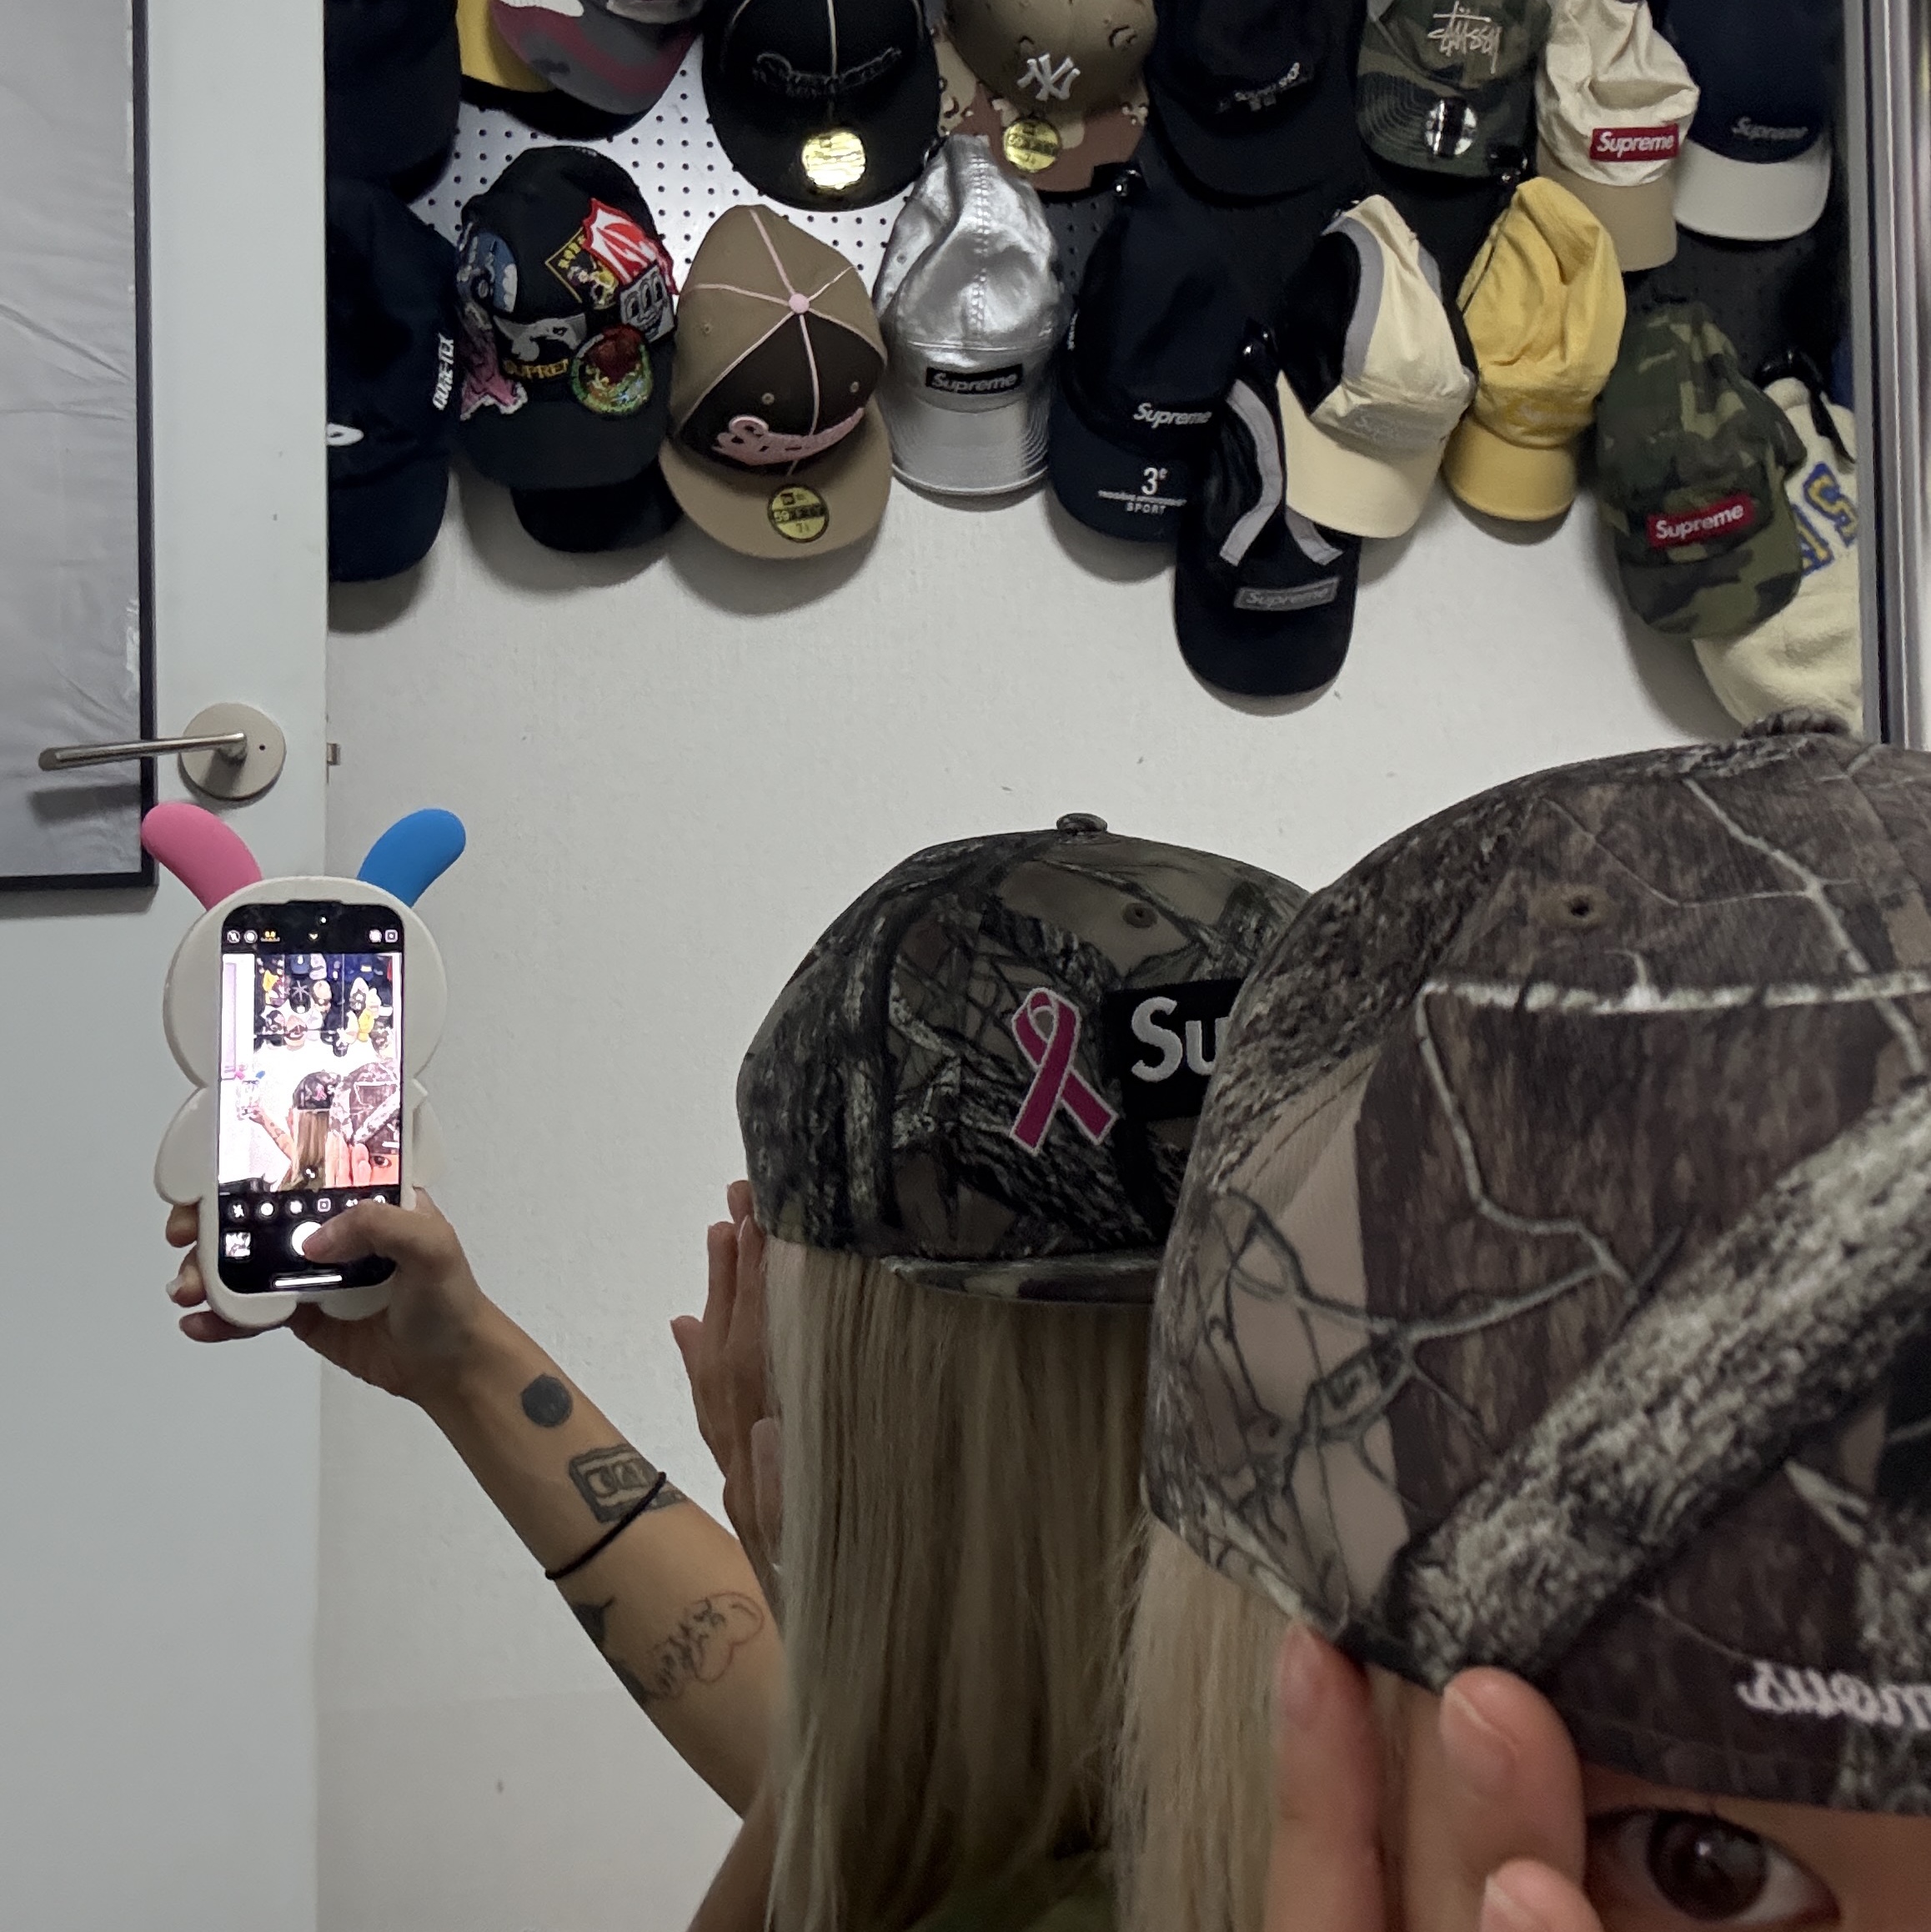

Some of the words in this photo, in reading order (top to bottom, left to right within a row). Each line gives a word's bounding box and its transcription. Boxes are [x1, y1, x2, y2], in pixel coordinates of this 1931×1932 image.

[1016, 53, 1081, 102] NY
[1597, 131, 1674, 158] Supreme
[931, 372, 1019, 393] Supreme
[1133, 402, 1212, 429] Supreme
[1126, 502, 1167, 514] SPORT
[1655, 504, 1744, 540] Supreme
